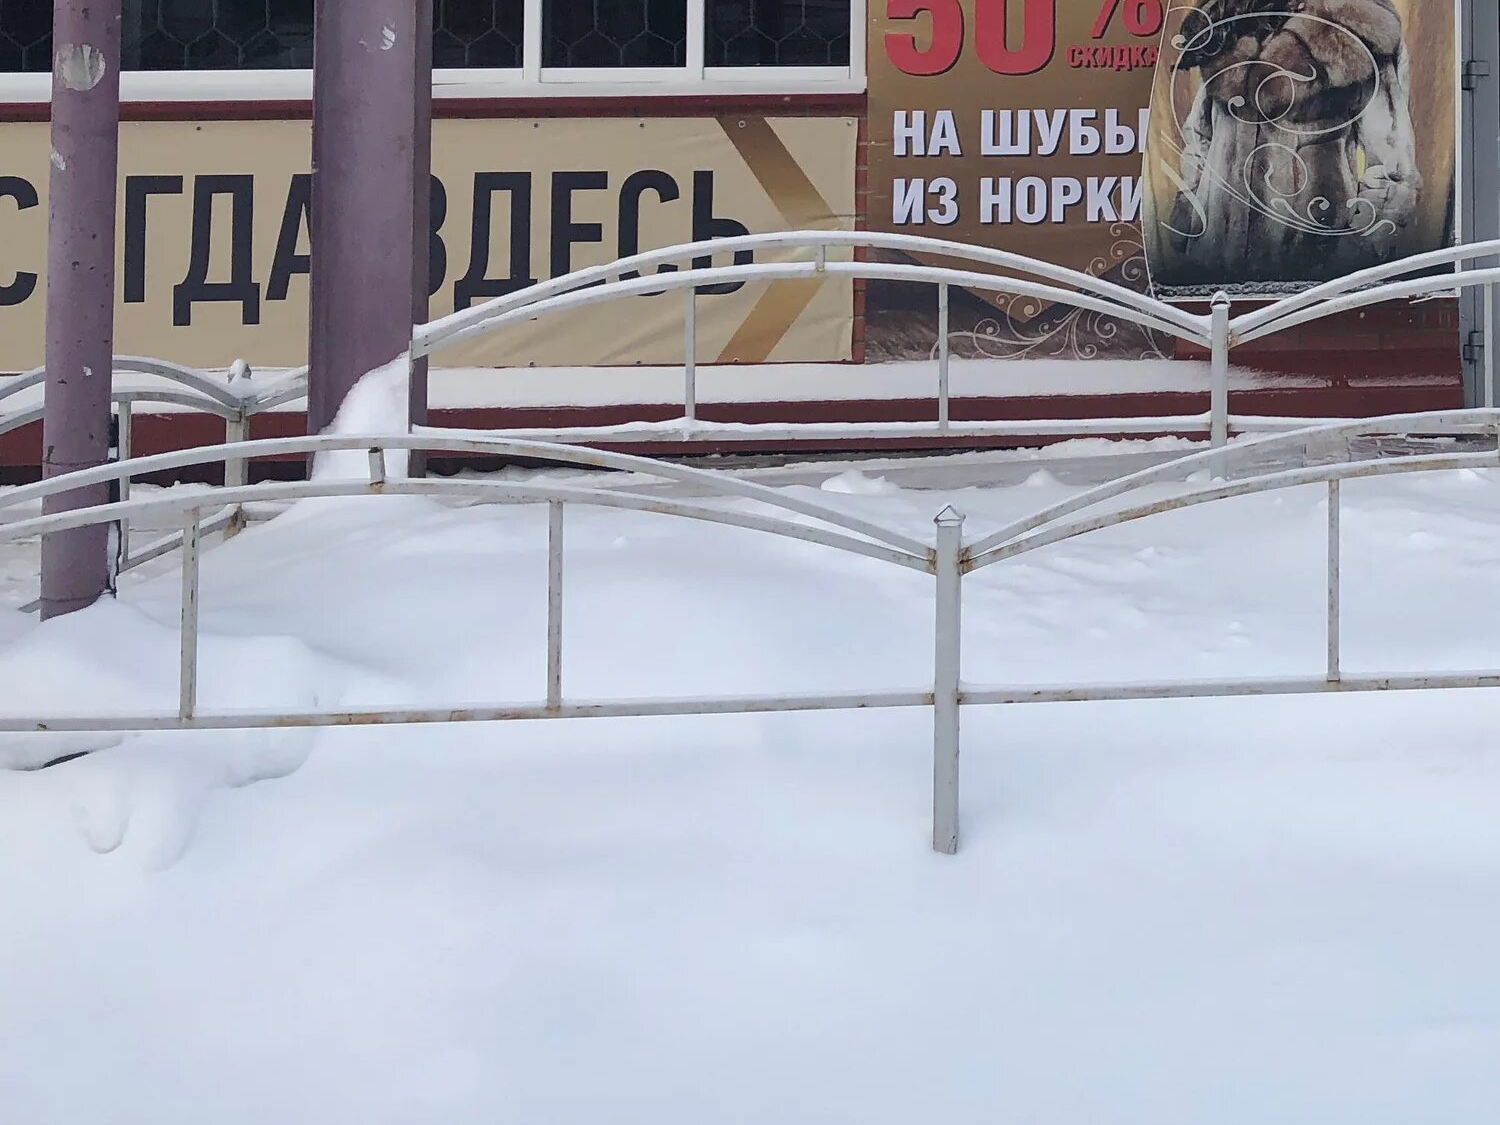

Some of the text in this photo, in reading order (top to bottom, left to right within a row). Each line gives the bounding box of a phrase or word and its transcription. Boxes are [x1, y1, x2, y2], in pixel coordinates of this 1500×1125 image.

[1066, 44, 1160, 71] СКИДКА
[893, 108, 1150, 156] НА ШУБЫ
[893, 177, 1144, 224] ИЗ НОРКИ
[0, 173, 312, 326] СГДА
